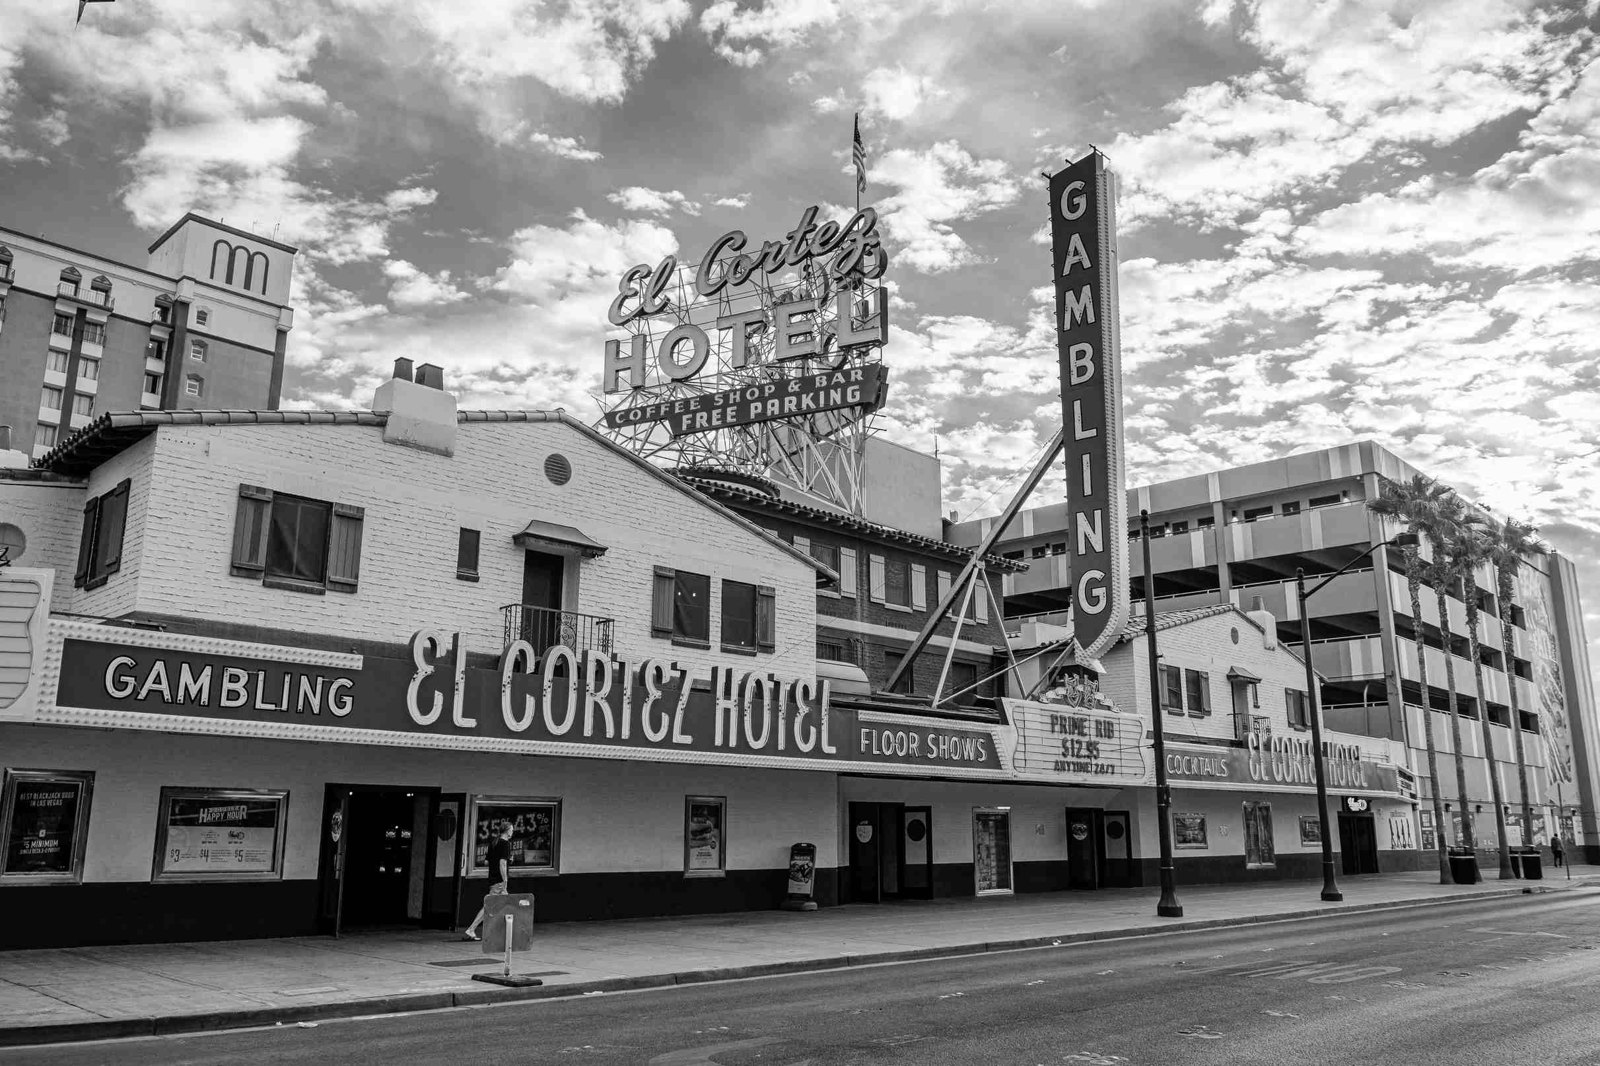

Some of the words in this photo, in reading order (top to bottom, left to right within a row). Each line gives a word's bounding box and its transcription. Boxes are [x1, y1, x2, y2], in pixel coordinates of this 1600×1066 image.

[608, 254, 677, 326] El
[696, 205, 880, 297] Cortez
[604, 288, 888, 394] HOTEL
[615, 397, 701, 424] COFFEE
[713, 384, 776, 406] SHOP
[787, 380, 802, 393] &
[815, 369, 864, 389] BAR
[681, 406, 738, 431] FREE
[749, 384, 861, 419] PARKING
[1059, 179, 1108, 616] GAMBLING
[104, 655, 355, 717] GAMBLING
[406, 628, 477, 728] EL
[500, 640, 694, 745] CORTEZ
[711, 665, 837, 754] HOTEL
[1050, 713, 1088, 737] PRIME
[1095, 719, 1115, 739] RIB
[860, 727, 919, 757] FLOOR
[927, 733, 987, 762] SHOWS
[1061, 737, 1100, 760] $12.95
[1248, 731, 1269, 781] EL
[1271, 736, 1322, 785] CORTE
[1327, 741, 1369, 787] HOTEL
[1053, 759, 1091, 773] ANYTIME
[1094, 762, 1115, 775] 24/7
[1166, 754, 1229, 777] COCKTAILS
[199, 808, 224, 823] HAPPY
[227, 805, 248, 820] HOUR
[514, 813, 549, 834] 43%
[170, 848, 180, 863] $3
[200, 848, 209, 863] $4
[234, 848, 244, 863] $5
